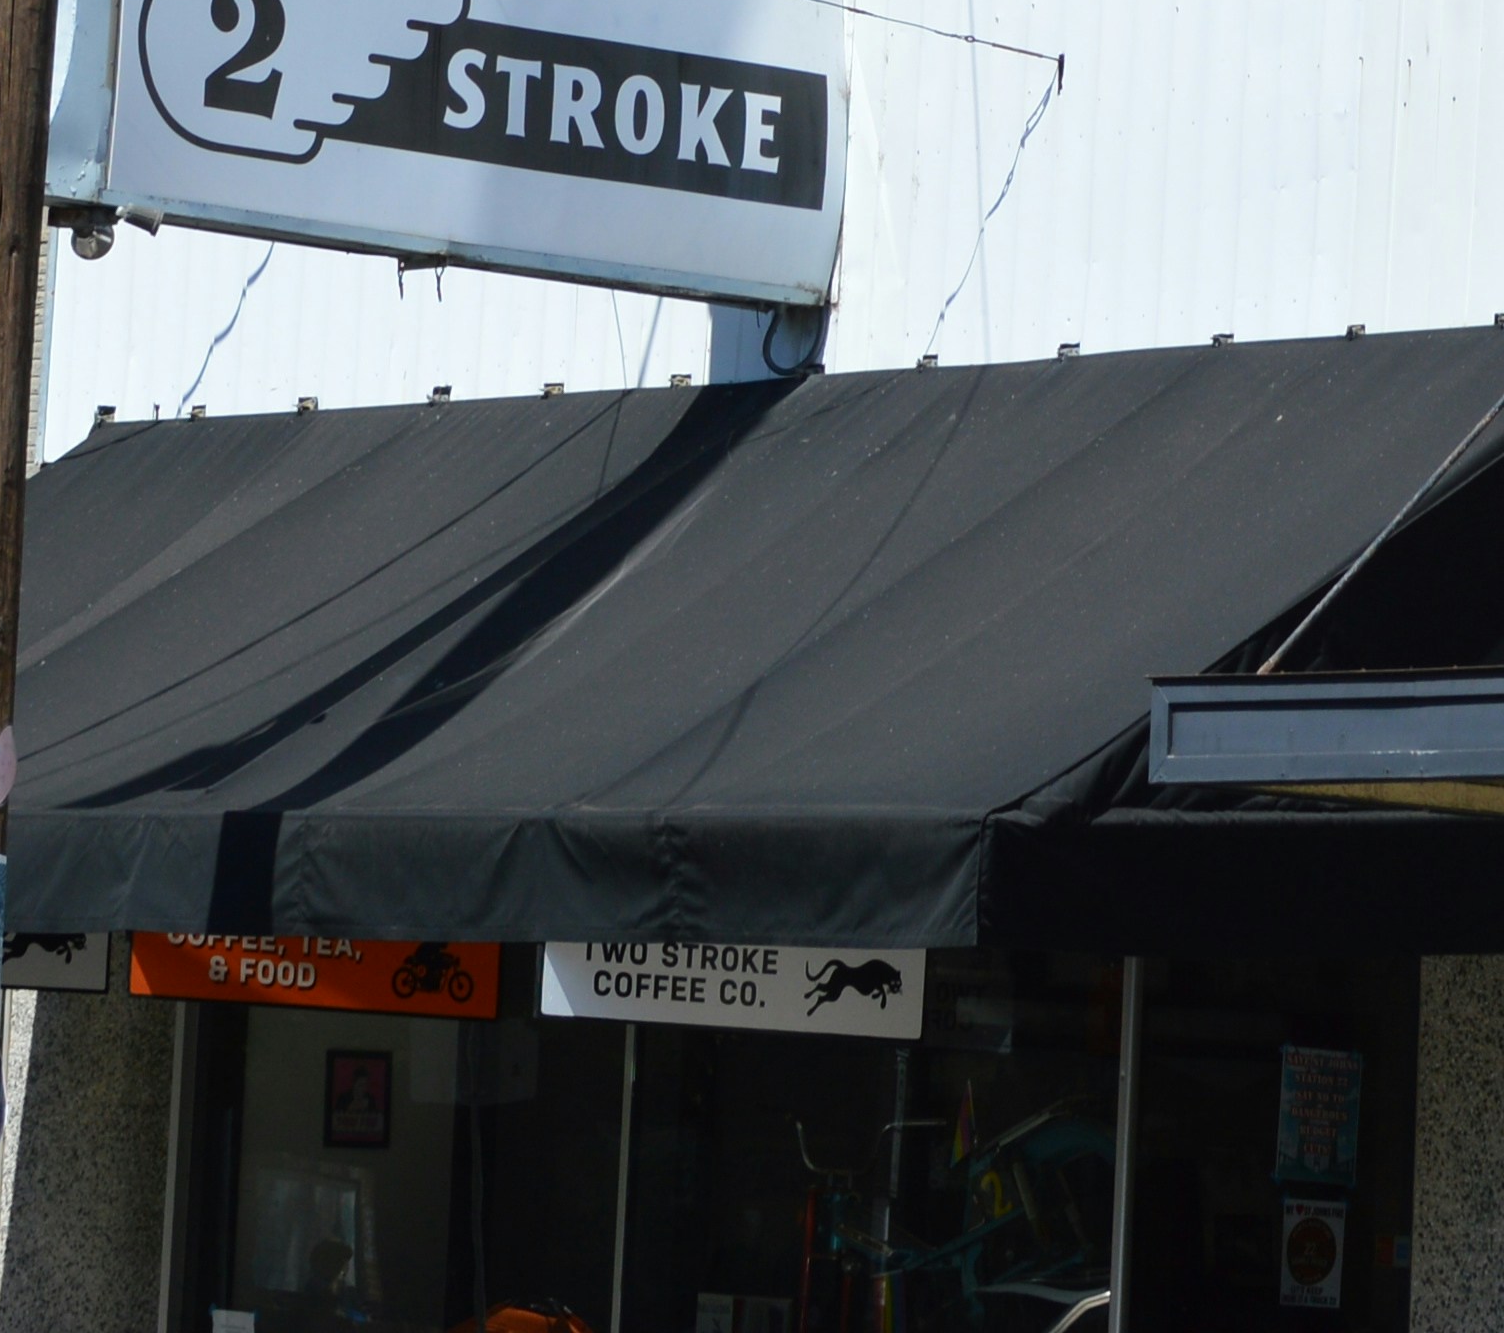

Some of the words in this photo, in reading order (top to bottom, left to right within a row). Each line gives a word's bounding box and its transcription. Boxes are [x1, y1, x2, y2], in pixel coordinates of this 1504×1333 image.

[443, 48, 782, 174] STROKE
[301, 937, 363, 962] TEA,
[585, 943, 649, 966] TWO
[661, 942, 780, 975] STROKE
[208, 954, 229, 982] &
[239, 958, 317, 989] FOOD
[593, 970, 706, 1003] COFFEE
[719, 979, 766, 1008] CO.
